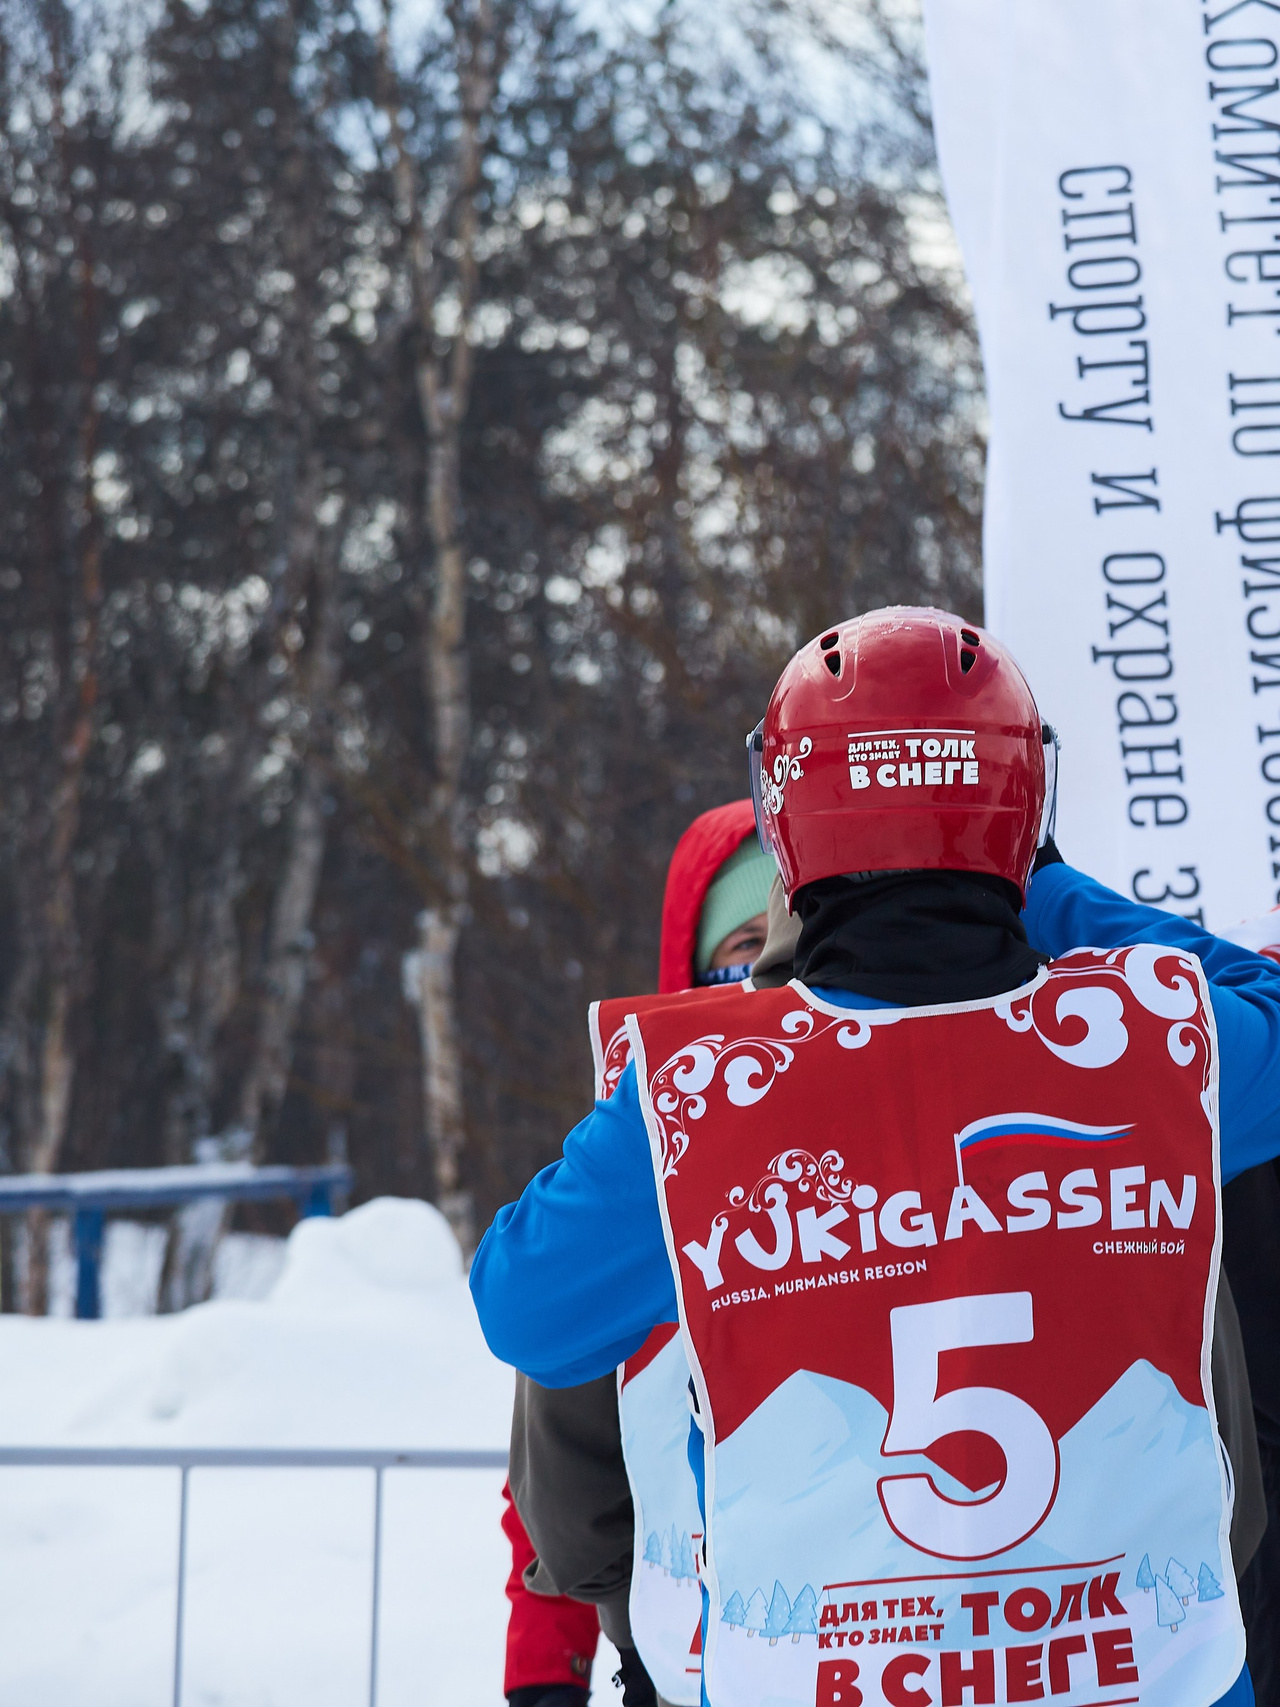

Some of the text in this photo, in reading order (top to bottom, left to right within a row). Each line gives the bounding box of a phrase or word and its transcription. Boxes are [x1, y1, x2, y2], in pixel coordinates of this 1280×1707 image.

[1049, 164, 1155, 432] спорту
[1090, 467, 1162, 516] и
[1091, 551, 1188, 828] охране
[848, 738, 976, 759] ДЛЯ ТЕХ, ТОЛК
[848, 751, 900, 763] КТО ЗНАЕТ
[849, 761, 979, 789] В СНЕГЕ
[1093, 1239, 1186, 1255] СНЕЖНЫЙ БОЙ
[711, 1259, 927, 1312] RUSSIA, MURMANSK REGION
[877, 1291, 1060, 1562] 5
[819, 1571, 1128, 1637] ДЛЯ ТЕХ, ТОЛК
[818, 1624, 945, 1649] КТО ЗНАЕТ
[815, 1628, 1140, 1707] В СНЕГЕ
